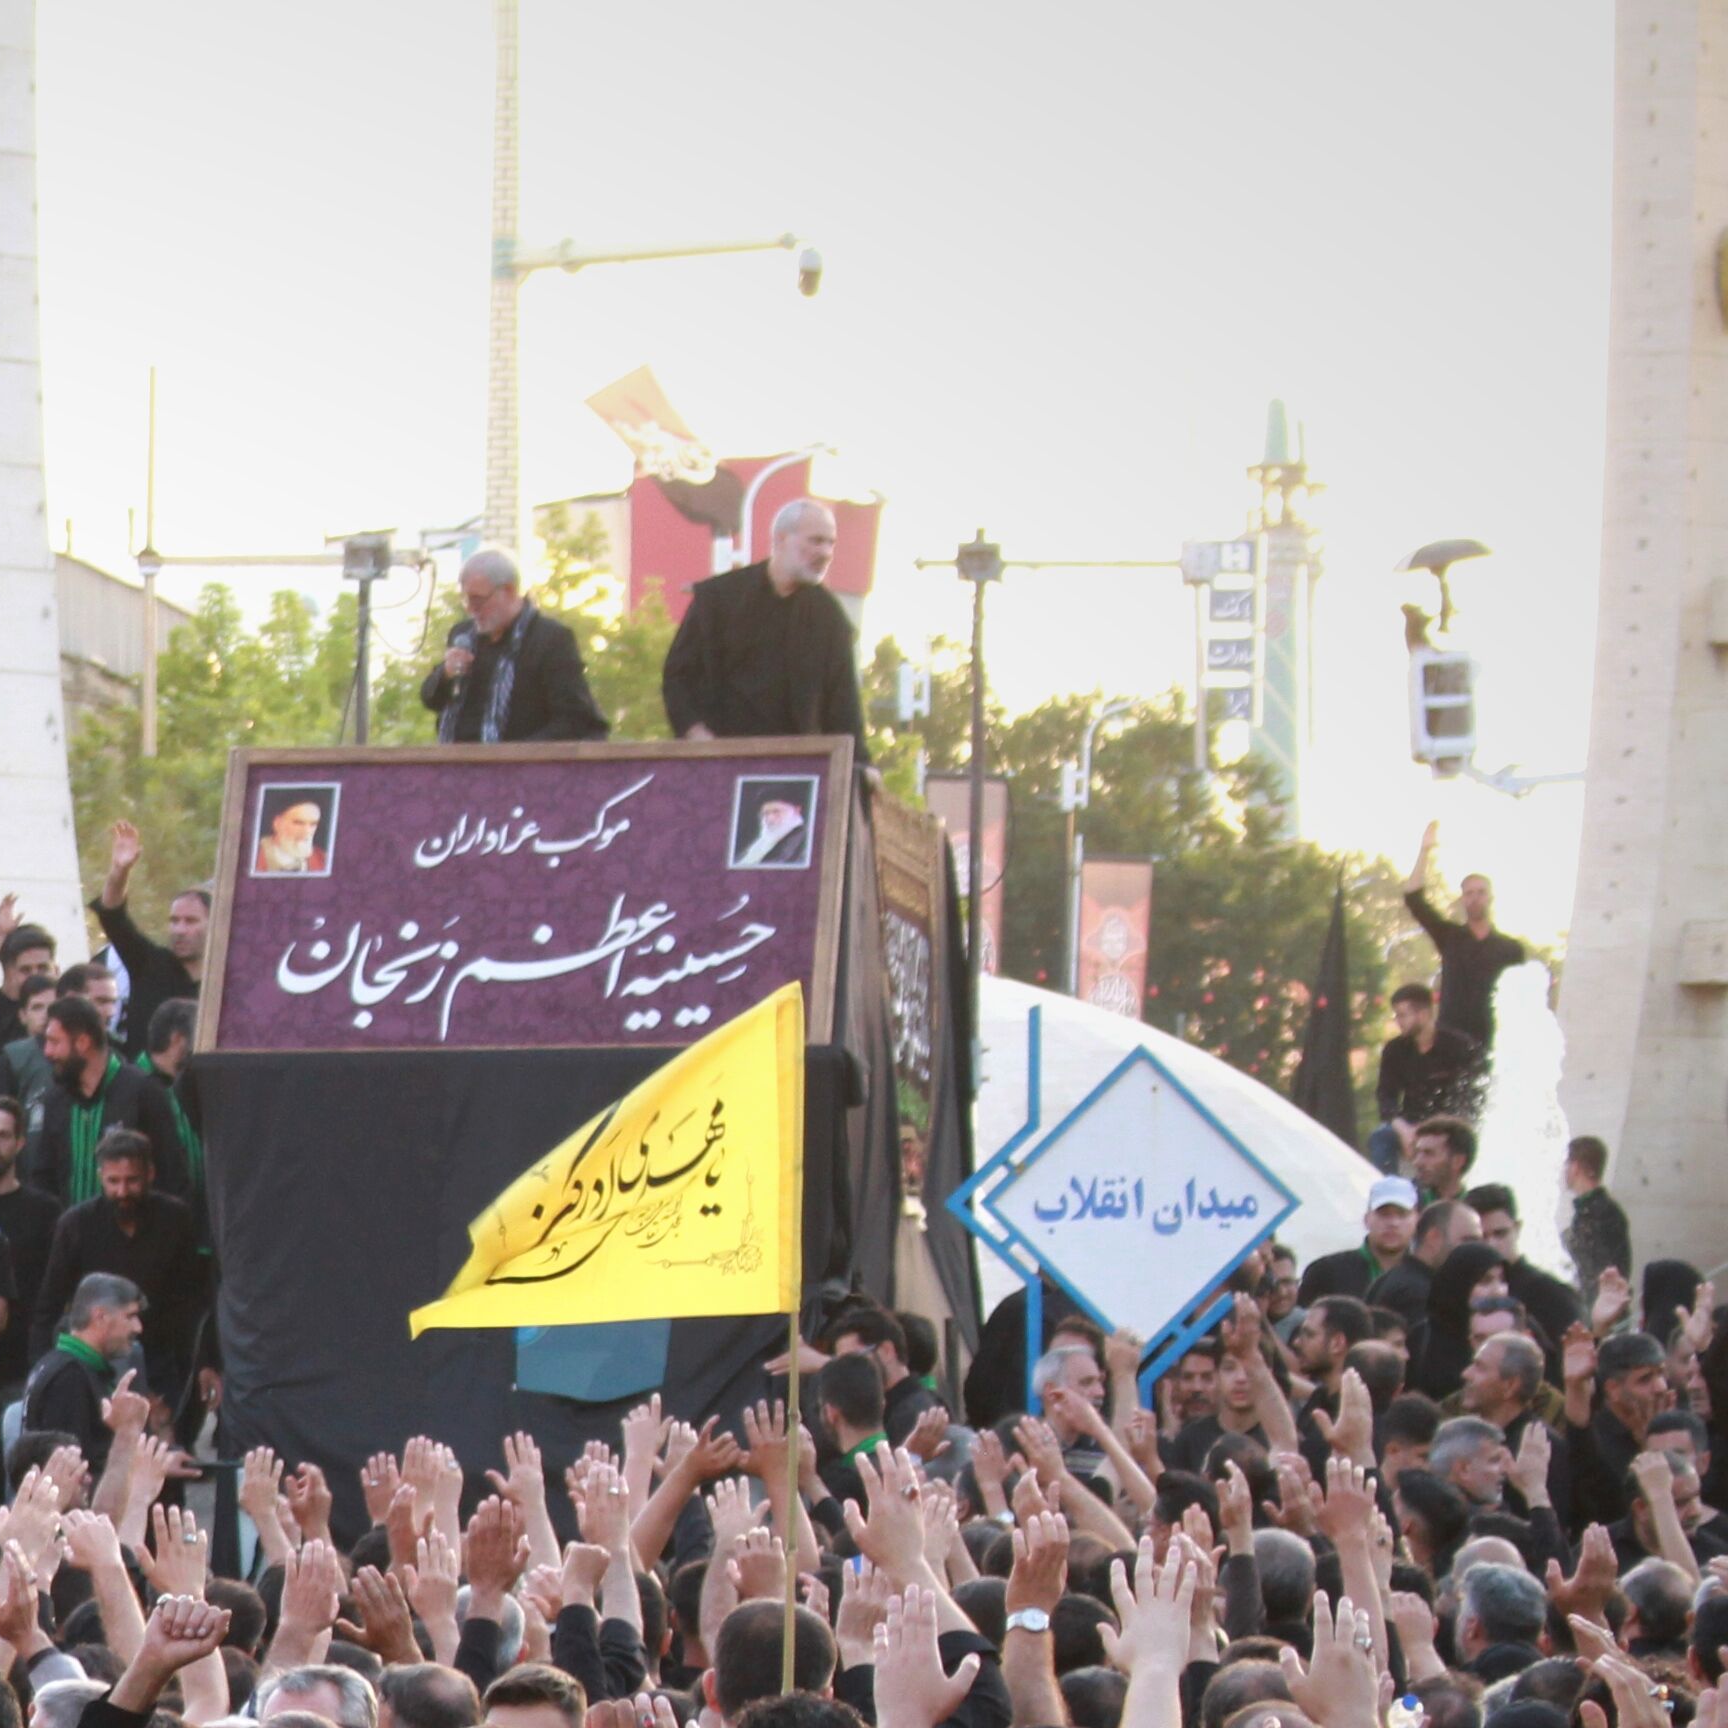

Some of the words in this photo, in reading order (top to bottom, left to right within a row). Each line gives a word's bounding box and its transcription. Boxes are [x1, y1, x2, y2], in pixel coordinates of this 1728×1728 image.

[414, 807, 542, 869] عزاداران
[534, 775, 654, 867] موکب
[276, 917, 459, 1028] زنجان
[441, 893, 676, 1042] اعظم
[700, 1145, 725, 1217] یا
[1033, 1174, 1144, 1235] انقلاب
[1151, 1176, 1259, 1235] میدان
